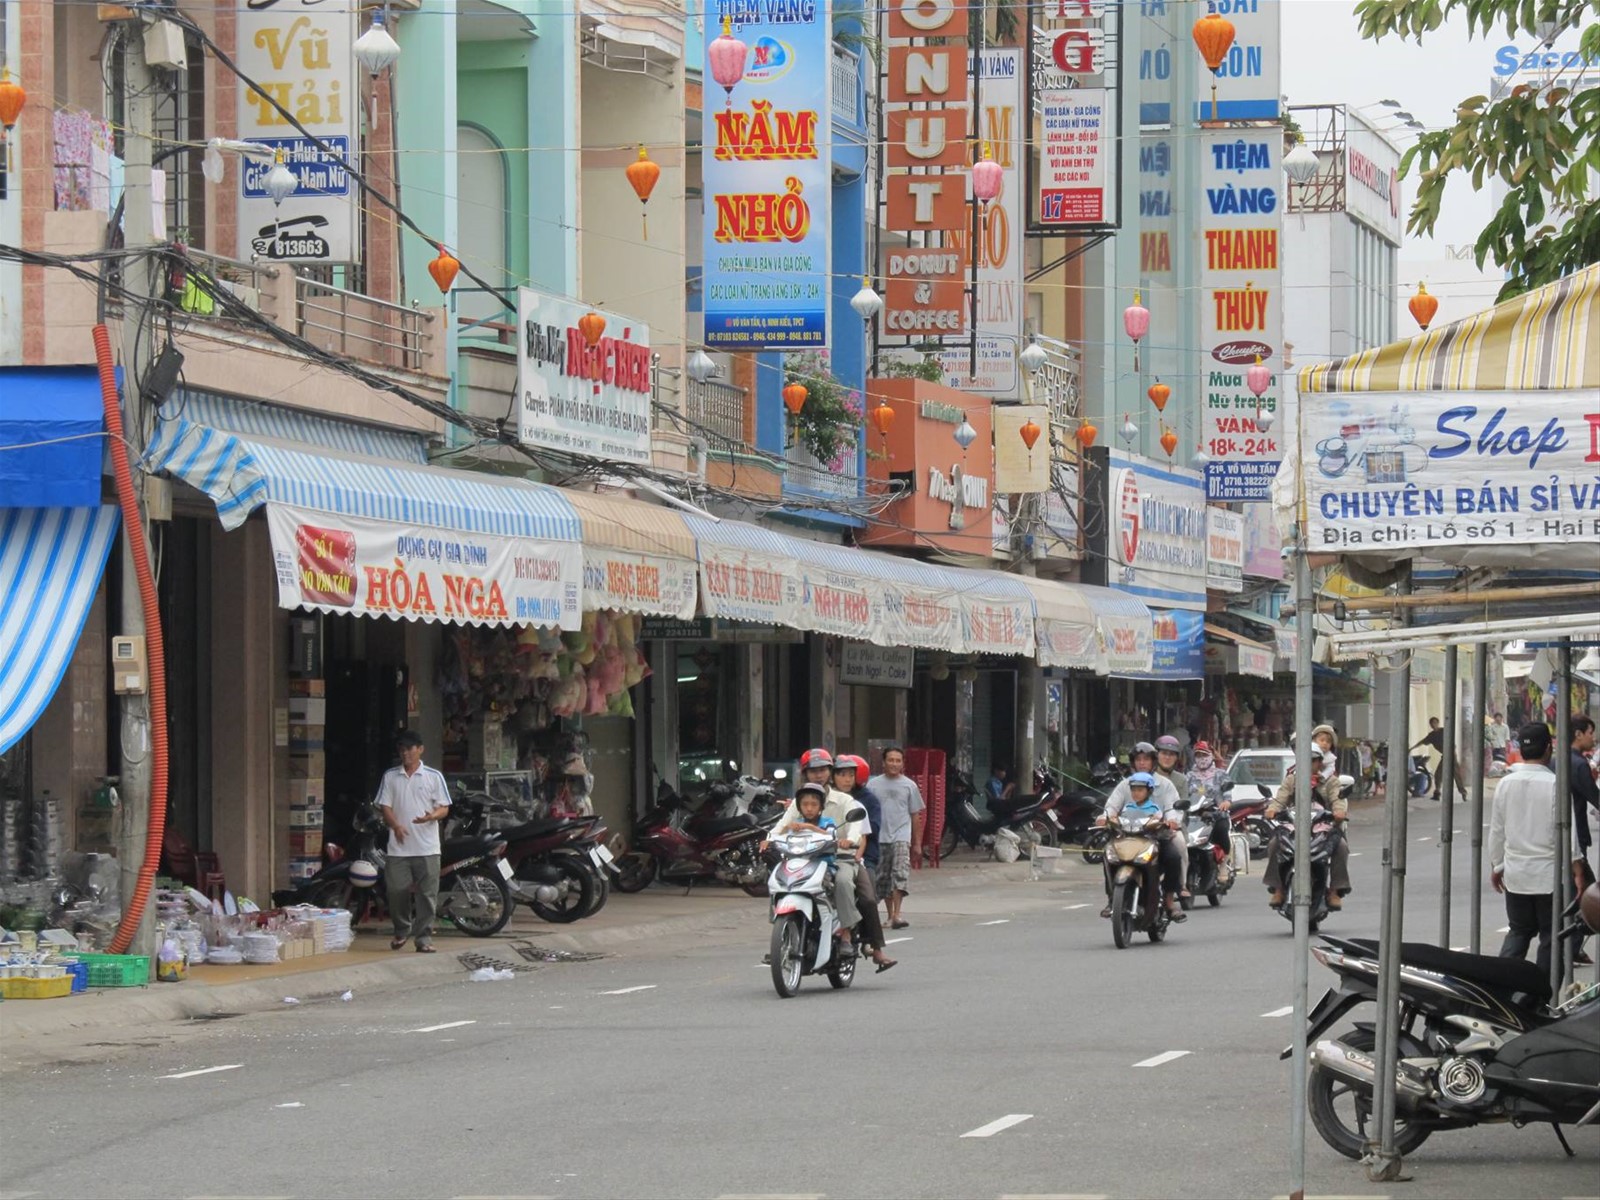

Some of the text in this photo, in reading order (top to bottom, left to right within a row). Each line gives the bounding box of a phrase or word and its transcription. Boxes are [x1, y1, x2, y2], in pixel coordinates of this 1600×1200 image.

[254, 16, 331, 71] Vũ
[990, 52, 1015, 76] VÀNG
[246, 79, 343, 127] Hải
[1044, 104, 1101, 116] MUA BÁN GIA CÔNG
[714, 99, 818, 161] NĂM
[1081, 118, 1099, 128] TRANG
[294, 140, 317, 163] Mua
[1056, 145, 1074, 155] TRANG
[1086, 145, 1098, 155] 24K
[1212, 139, 1270, 174] TIỆM
[1061, 158, 1072, 168] ANH
[301, 163, 346, 188] Nam Nữ
[714, 175, 811, 243] NHỎ
[1042, 192, 1063, 219] 17
[1207, 183, 1277, 215] VÀNG
[276, 239, 323, 256] 813663
[1205, 228, 1278, 270] THANH
[784, 256, 793, 271] GIA
[889, 254, 959, 276] DONUT
[751, 284, 771, 300] TRANG
[915, 283, 931, 304] &
[1213, 282, 1269, 331] THÚY
[887, 309, 960, 331] COFFEE
[614, 327, 650, 394] BÍCH
[1208, 371, 1242, 387] Mua
[1234, 394, 1276, 413] trang
[1216, 413, 1258, 433] VÀN
[1429, 405, 1569, 469] Shop
[1259, 462, 1276, 474] TẤN
[1320, 483, 1444, 520] CHUYÊN
[1456, 480, 1519, 515] BÁN
[1531, 475, 1559, 512] SỈ
[1323, 526, 1363, 546] Địa
[1371, 523, 1416, 542] chỉ:
[1427, 523, 1458, 540] Lô
[1466, 519, 1496, 538] số
[1505, 521, 1515, 538] 1
[1544, 519, 1583, 536] Hai
[397, 535, 488, 566] DỤNG CỤ GIA ĐÌNH
[363, 556, 437, 616] HÒA
[442, 574, 509, 620] NGA
[888, 665, 907, 679] Cake
